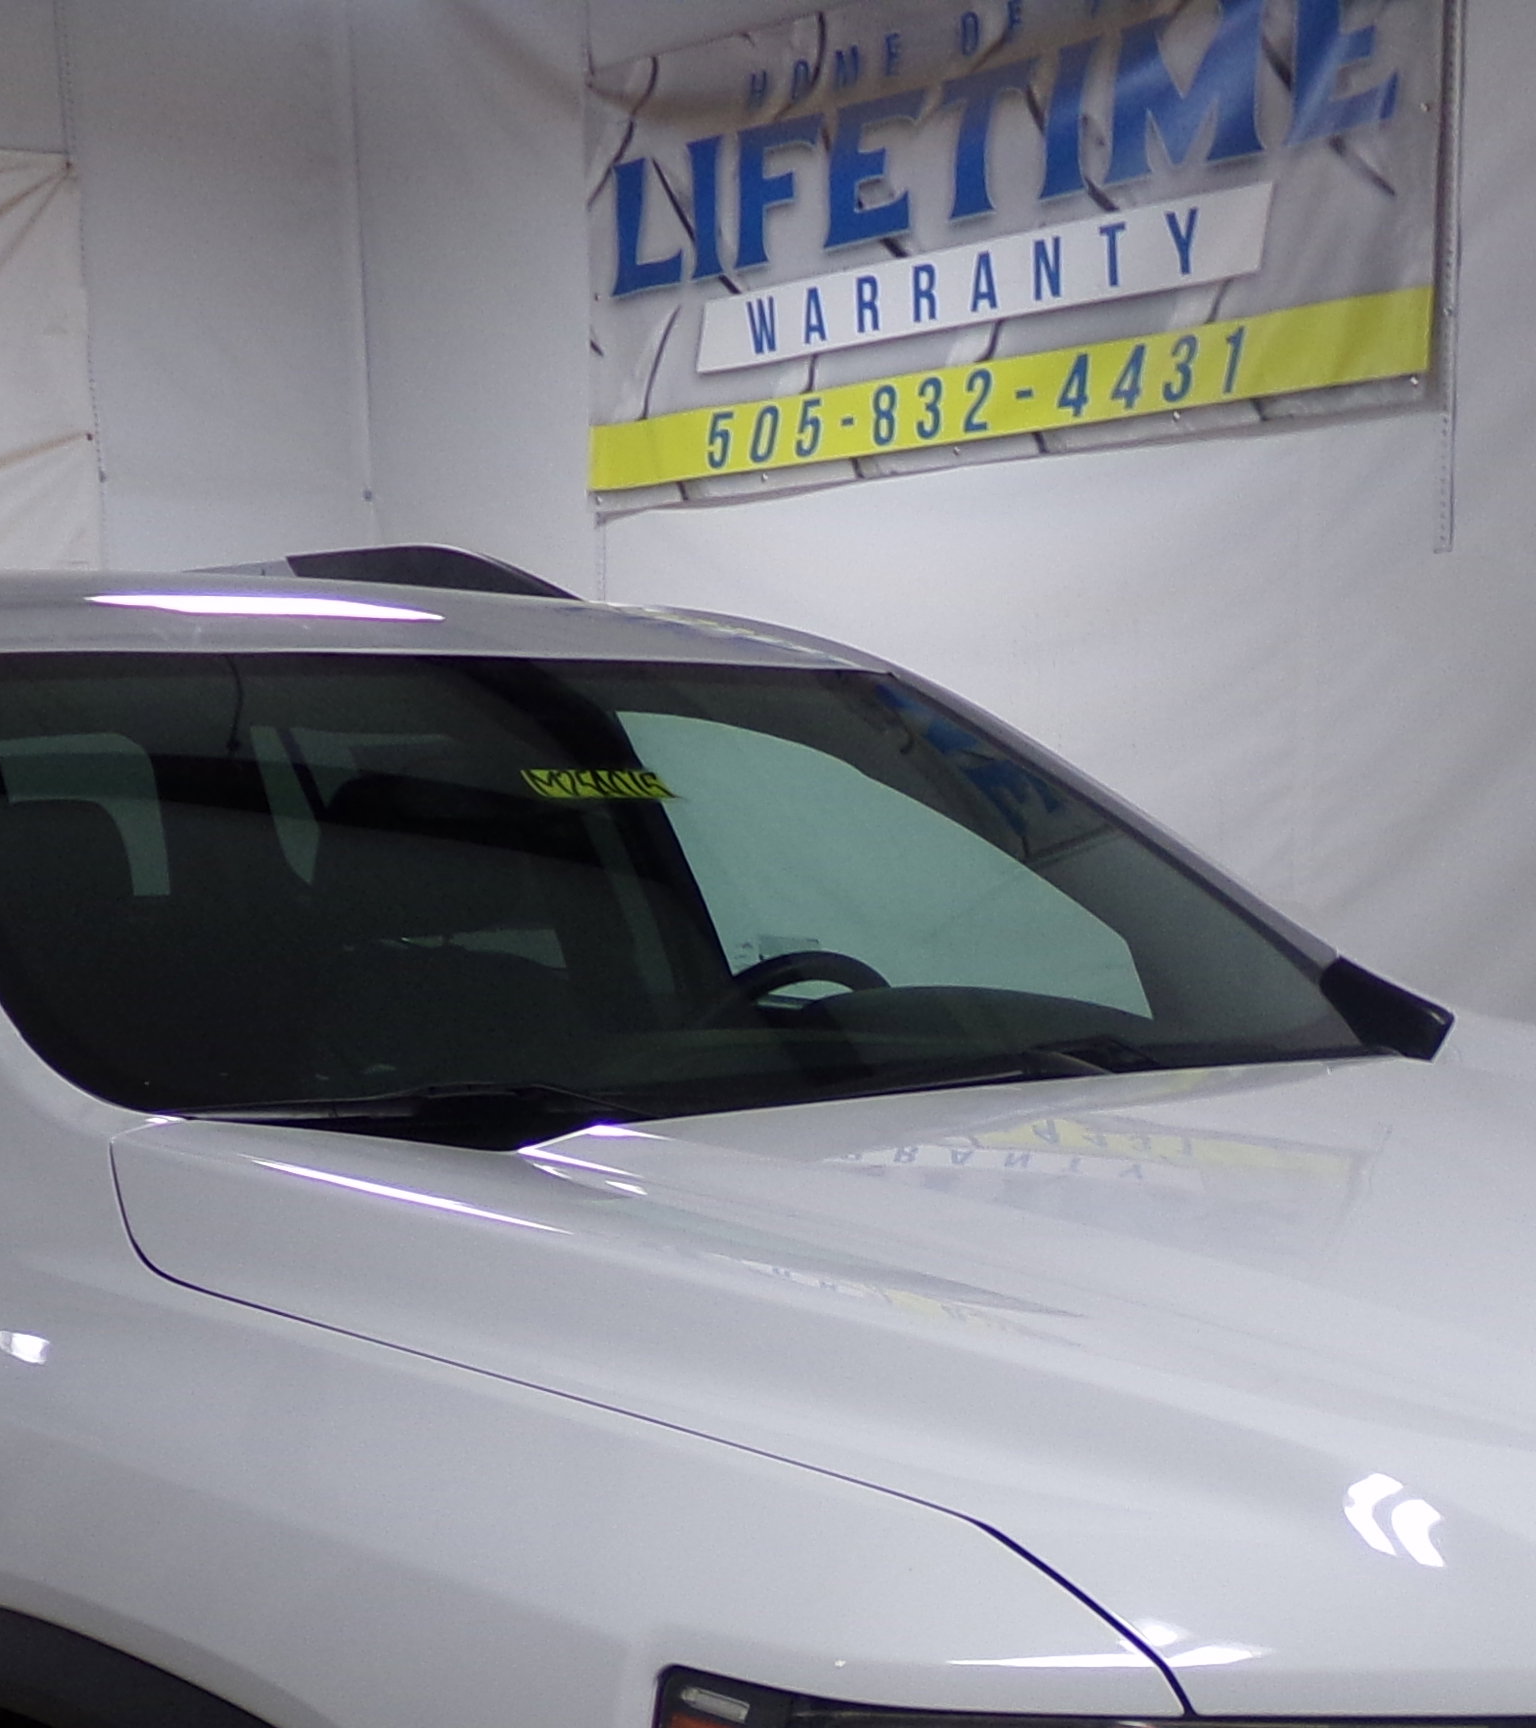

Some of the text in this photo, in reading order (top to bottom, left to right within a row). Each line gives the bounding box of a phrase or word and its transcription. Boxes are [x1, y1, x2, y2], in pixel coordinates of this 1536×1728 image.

[748, 32, 902, 105] HOME
[610, 0, 1400, 299] LIFETIME
[747, 207, 1201, 357] WARRANTY
[707, 325, 1249, 470] 505-832-4431
